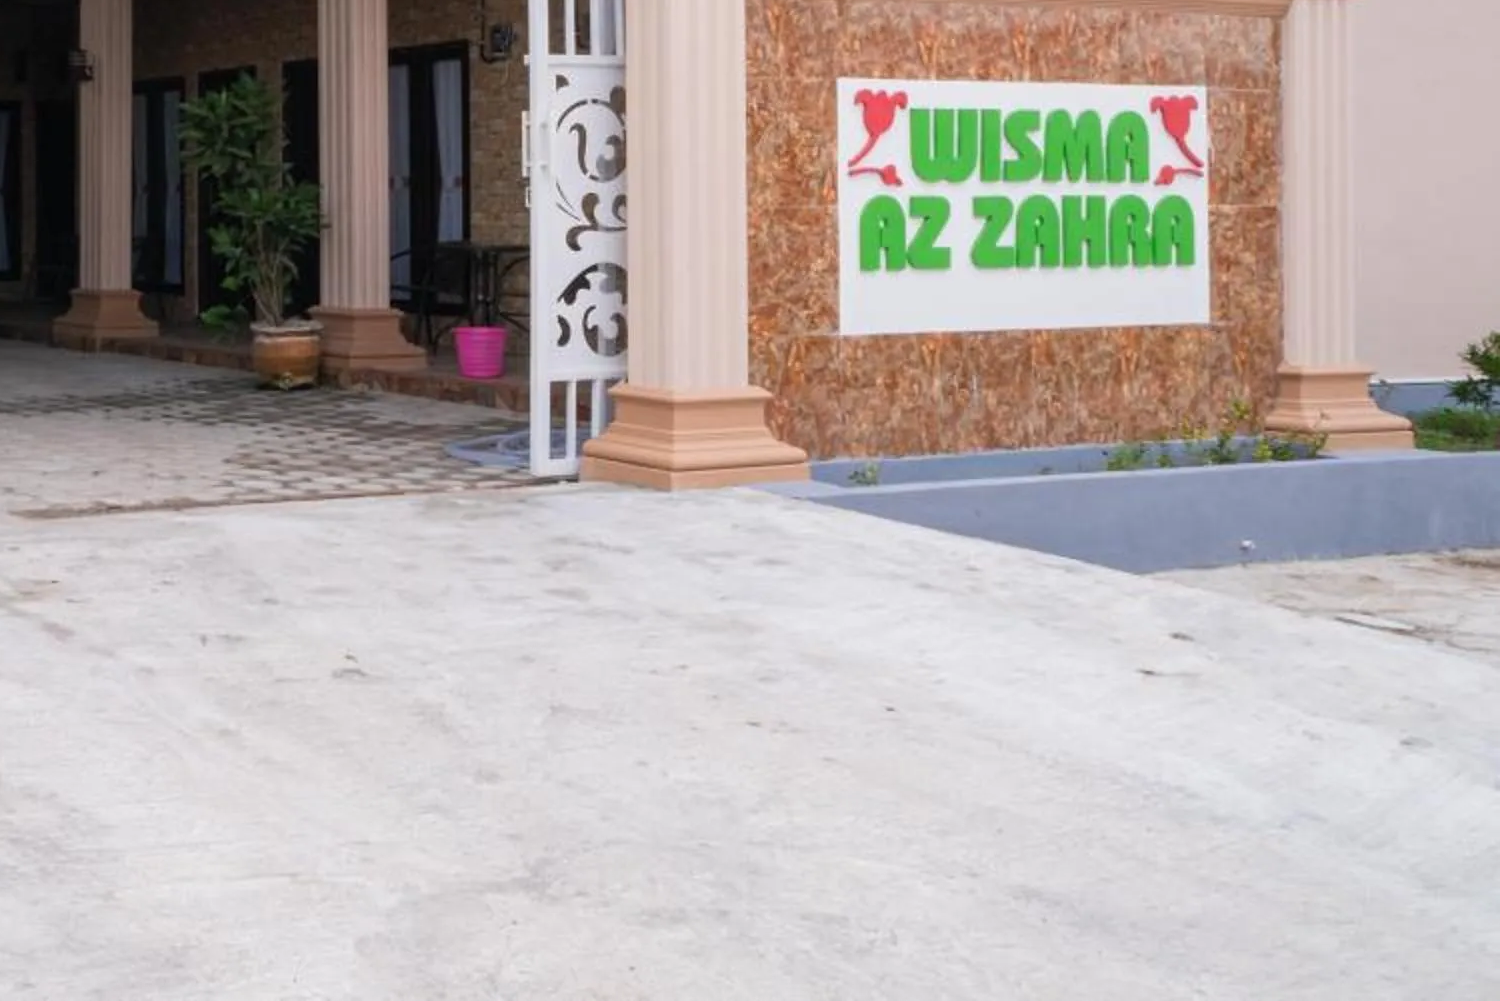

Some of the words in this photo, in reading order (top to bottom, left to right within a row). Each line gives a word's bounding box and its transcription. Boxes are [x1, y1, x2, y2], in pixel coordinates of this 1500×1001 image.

[909, 108, 1150, 184] WISMA
[859, 194, 951, 272] AZ
[971, 194, 1195, 270] ZAHRA
